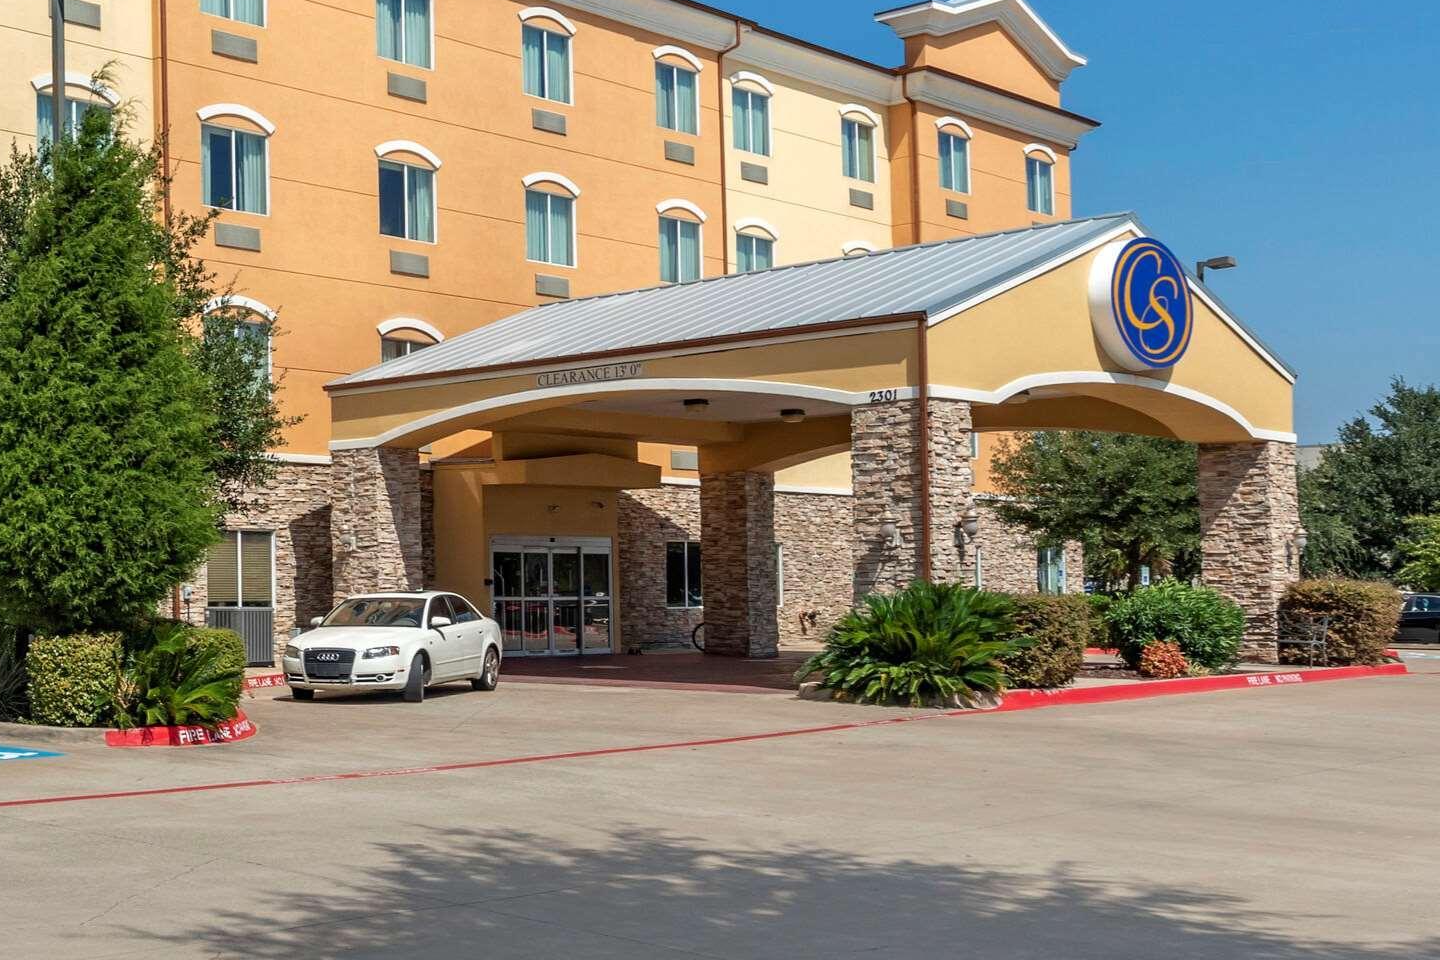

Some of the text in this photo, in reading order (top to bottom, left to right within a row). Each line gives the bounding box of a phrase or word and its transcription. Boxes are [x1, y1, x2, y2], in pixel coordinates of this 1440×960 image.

[537, 368, 610, 386] CLEARANCE
[869, 389, 897, 398] 2301
[179, 728, 205, 744] FIRE
